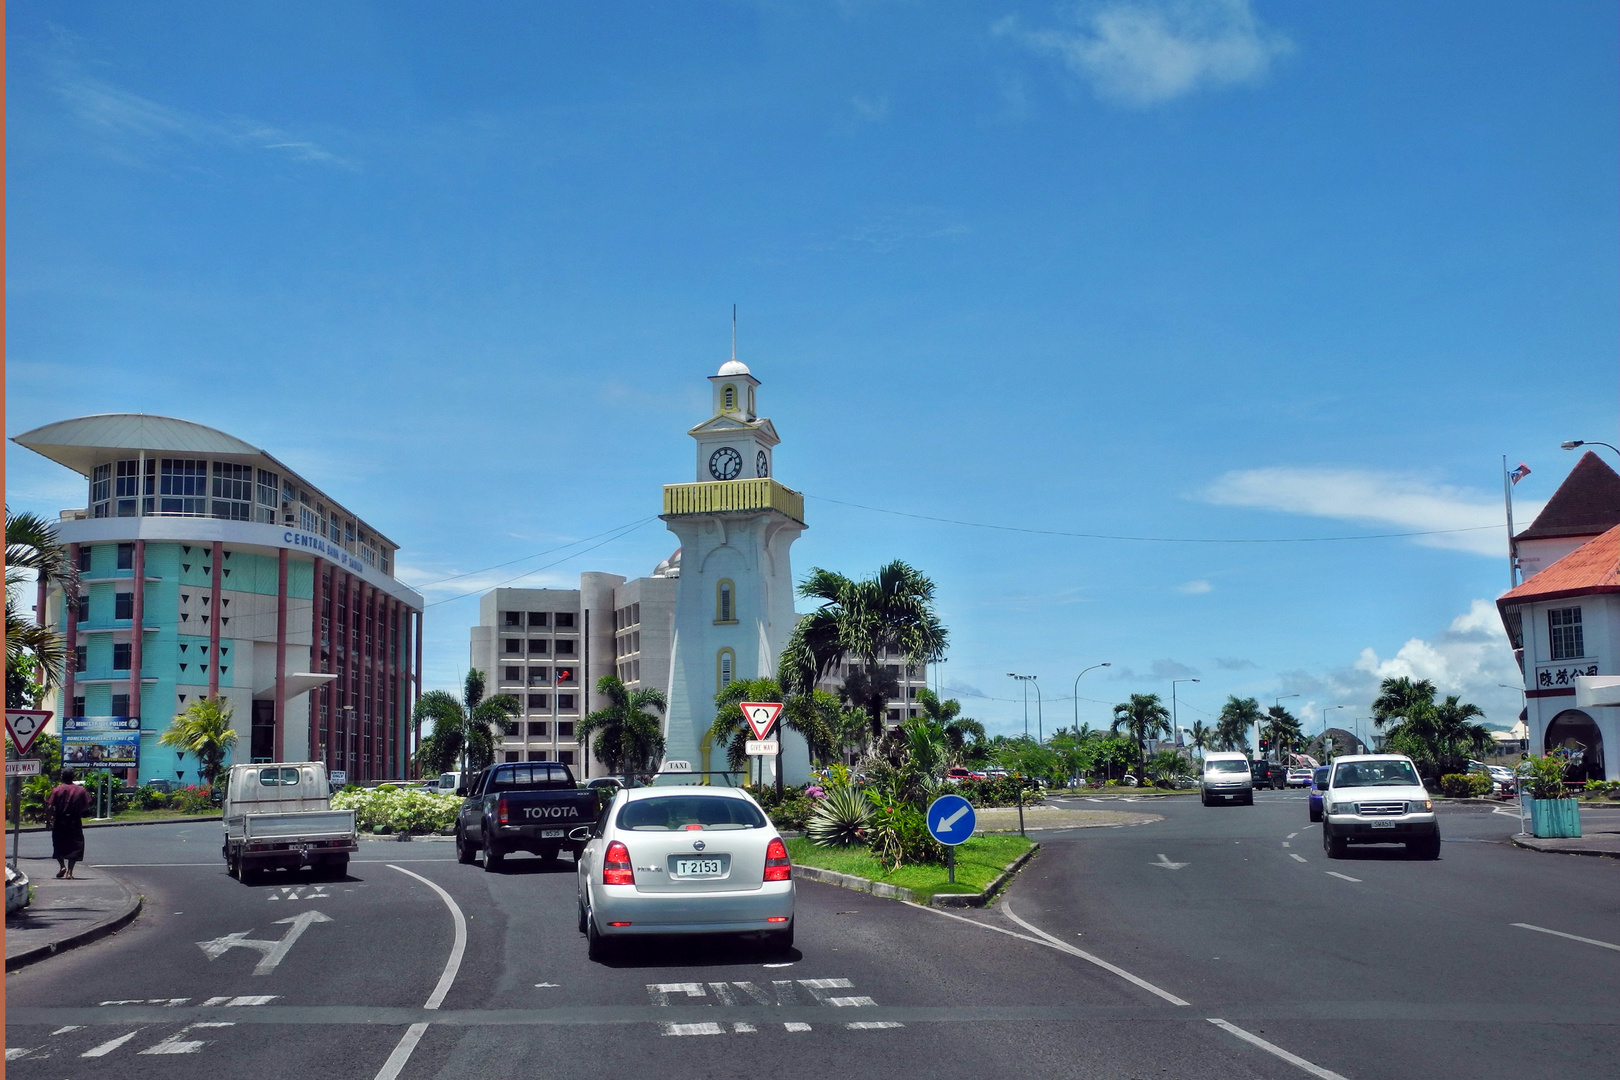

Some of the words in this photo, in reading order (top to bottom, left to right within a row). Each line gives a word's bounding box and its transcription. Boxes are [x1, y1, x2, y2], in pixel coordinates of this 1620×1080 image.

[284, 532, 325, 552] CENTRAL
[327, 545, 339, 559] BANK
[6, 764, 19, 772] GIVE
[523, 806, 579, 818] TOYOTA
